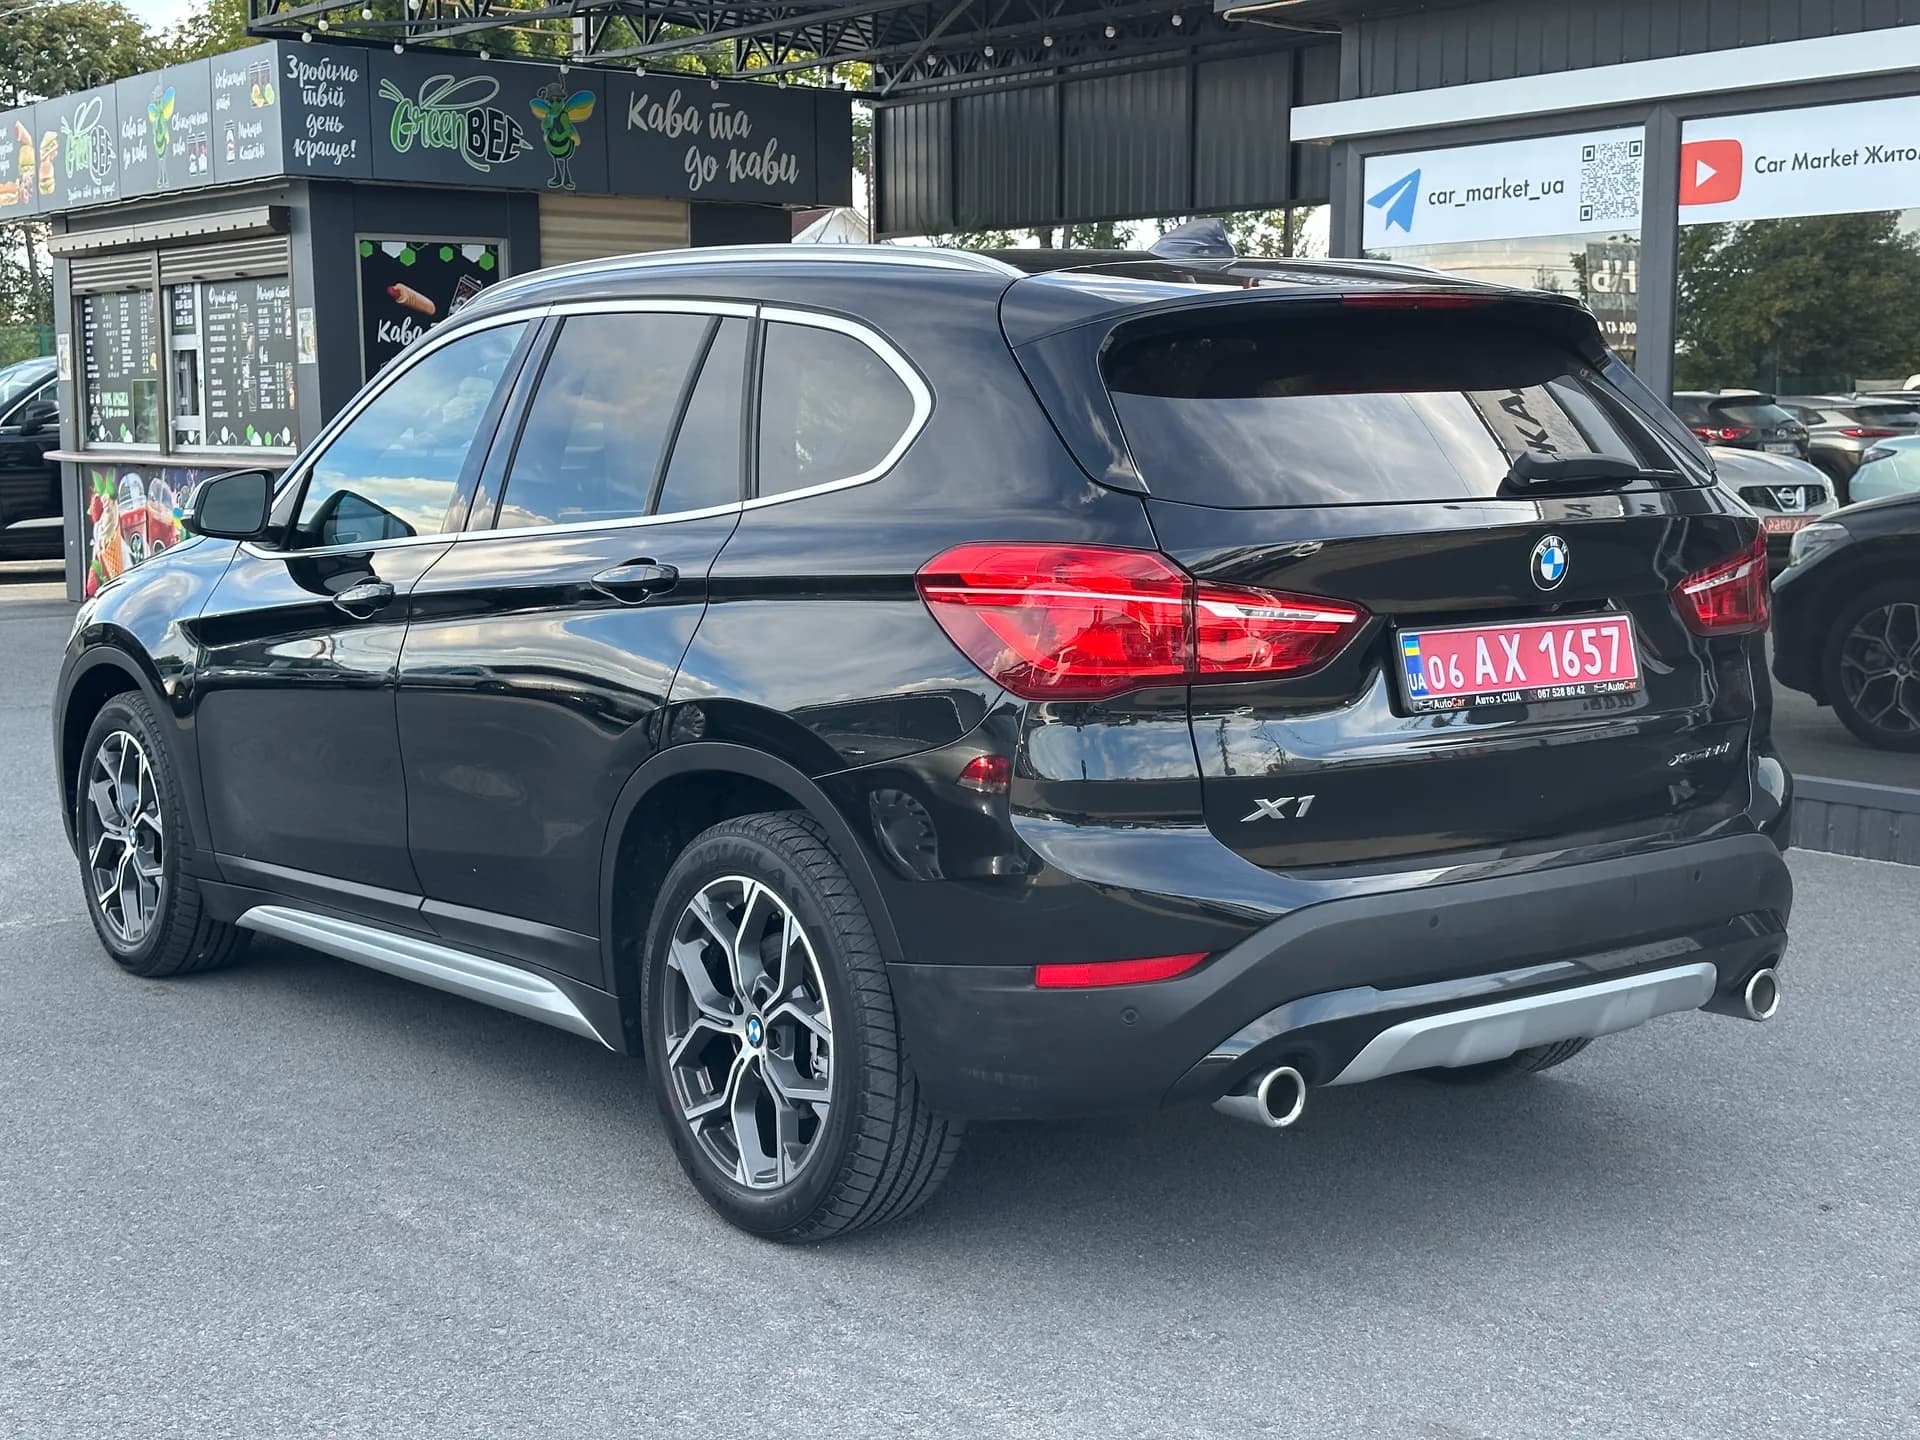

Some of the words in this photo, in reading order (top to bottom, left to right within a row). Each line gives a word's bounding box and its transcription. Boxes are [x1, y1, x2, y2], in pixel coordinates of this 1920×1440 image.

[287, 54, 359, 87] Зробимо
[302, 82, 346, 108] твій
[306, 112, 345, 138] день
[627, 88, 703, 139] Кава
[708, 102, 753, 141] та
[292, 138, 357, 166] краще!
[684, 144, 719, 191] до
[726, 136, 800, 186] кави
[1754, 153, 1787, 174] Car
[1791, 148, 1859, 171] Market
[1863, 144, 1920, 165] Жито
[1428, 176, 1565, 207] car_market_ua
[1427, 653, 1465, 691] 06
[1474, 634, 1527, 686] AX
[1537, 626, 1623, 680] 1657
[1408, 674, 1428, 692] UA
[1501, 691, 1522, 703] США
[1576, 685, 1586, 695] 42
[1607, 680, 1637, 692] AutoCar
[1434, 697, 1466, 710] AutoCar
[1240, 794, 1316, 822] X1
